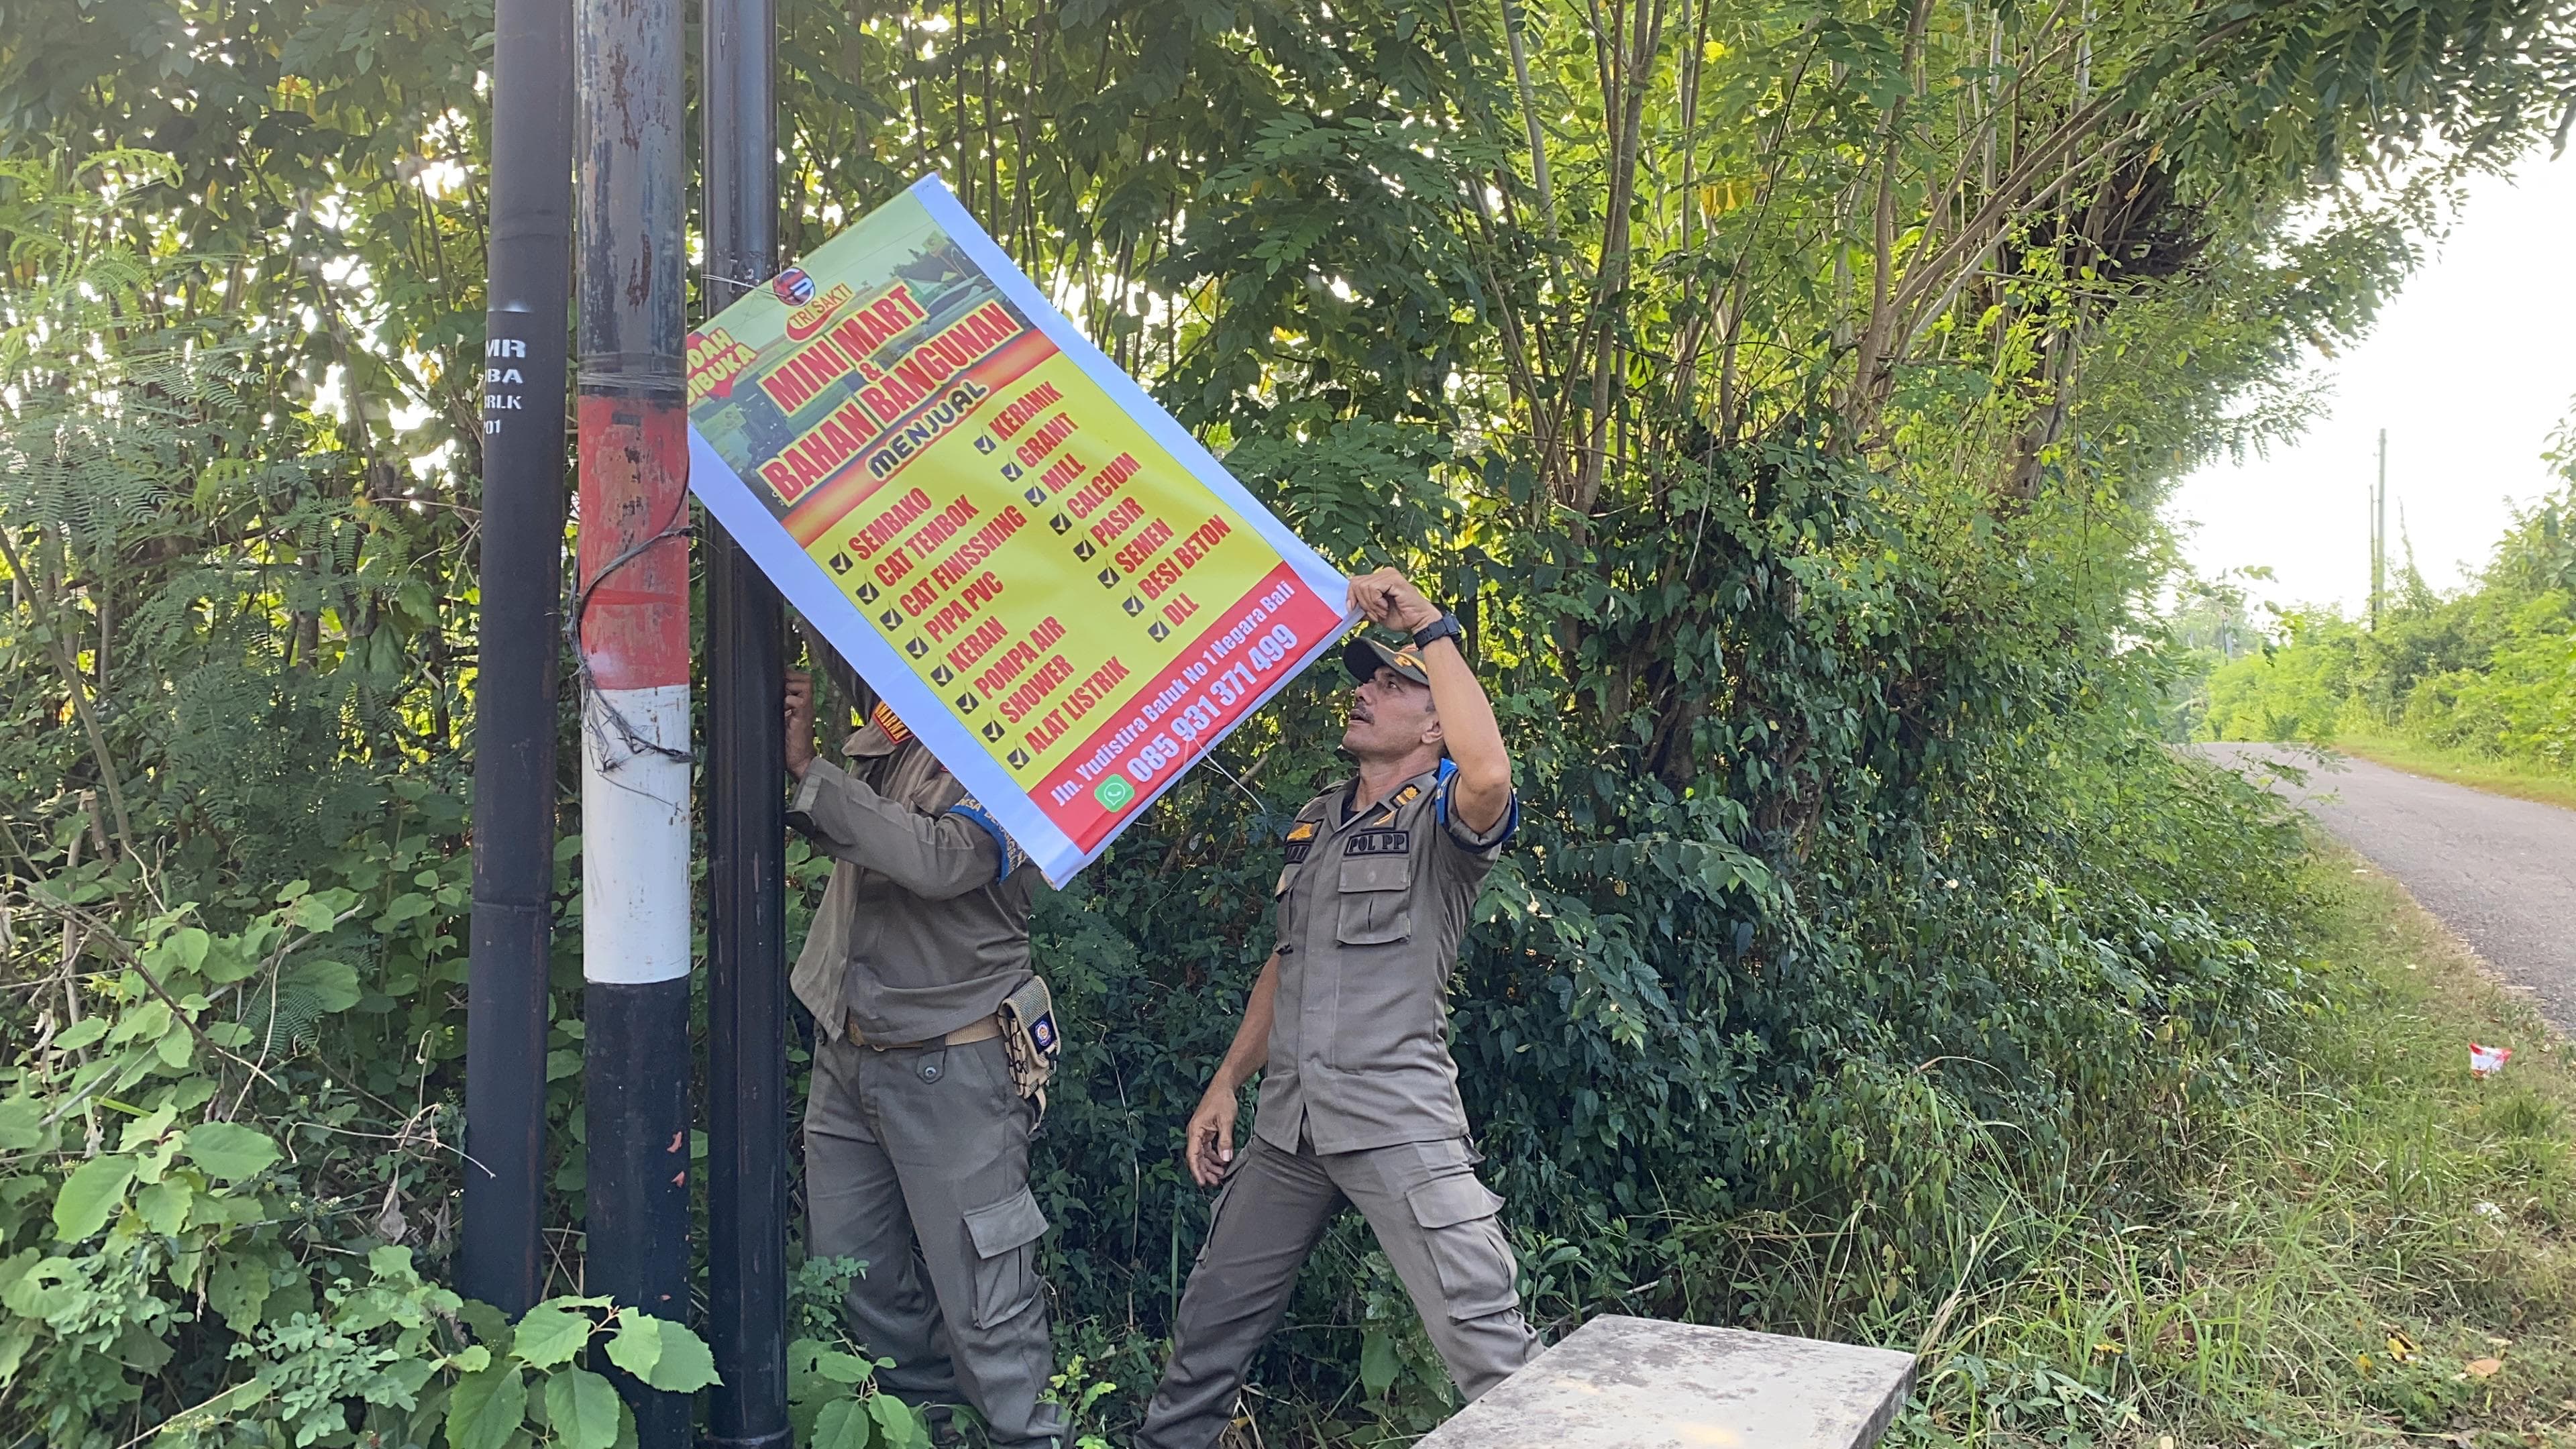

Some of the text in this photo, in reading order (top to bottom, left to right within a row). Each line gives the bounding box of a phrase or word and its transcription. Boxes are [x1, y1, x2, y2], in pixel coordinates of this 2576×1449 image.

[790, 283, 853, 327] TRI SAKTI
[485, 368, 523, 384] BA
[687, 329, 733, 375] DAH
[763, 284, 925, 413] MINI MART
[858, 362, 882, 382] &
[484, 394, 522, 409] RLK
[762, 303, 1018, 502] BAHAN BANGUNAN
[869, 382, 987, 478] MENJUAL
[988, 380, 1064, 441] KERAMIK
[1016, 412, 1079, 468] GRANIT
[1040, 452, 1086, 494] MILL
[1067, 451, 1142, 519] CALCIUM
[849, 487, 932, 560] SEMBAKO
[874, 494, 979, 587] CAT TEMBOK
[1089, 496, 1144, 547] PASIR
[1115, 517, 1174, 574] SEMEN
[900, 505, 1027, 617] CAT FINISSHING
[1138, 514, 1232, 600] BESI BETON
[924, 571, 1004, 643] PIPA PVC
[1163, 592, 1199, 627] DLL
[946, 615, 1008, 673] KERAN
[973, 616, 1066, 700] POMPA AIR
[999, 654, 1075, 724] SHOWER
[1024, 655, 1130, 755] ALAT LISTRIK
[1050, 580, 1295, 807] Jln. Yudistira Baluk No 1 Negara Bali
[1126, 623, 1298, 783] 085 931 371 499
[1350, 834, 1405, 852] POL PP
